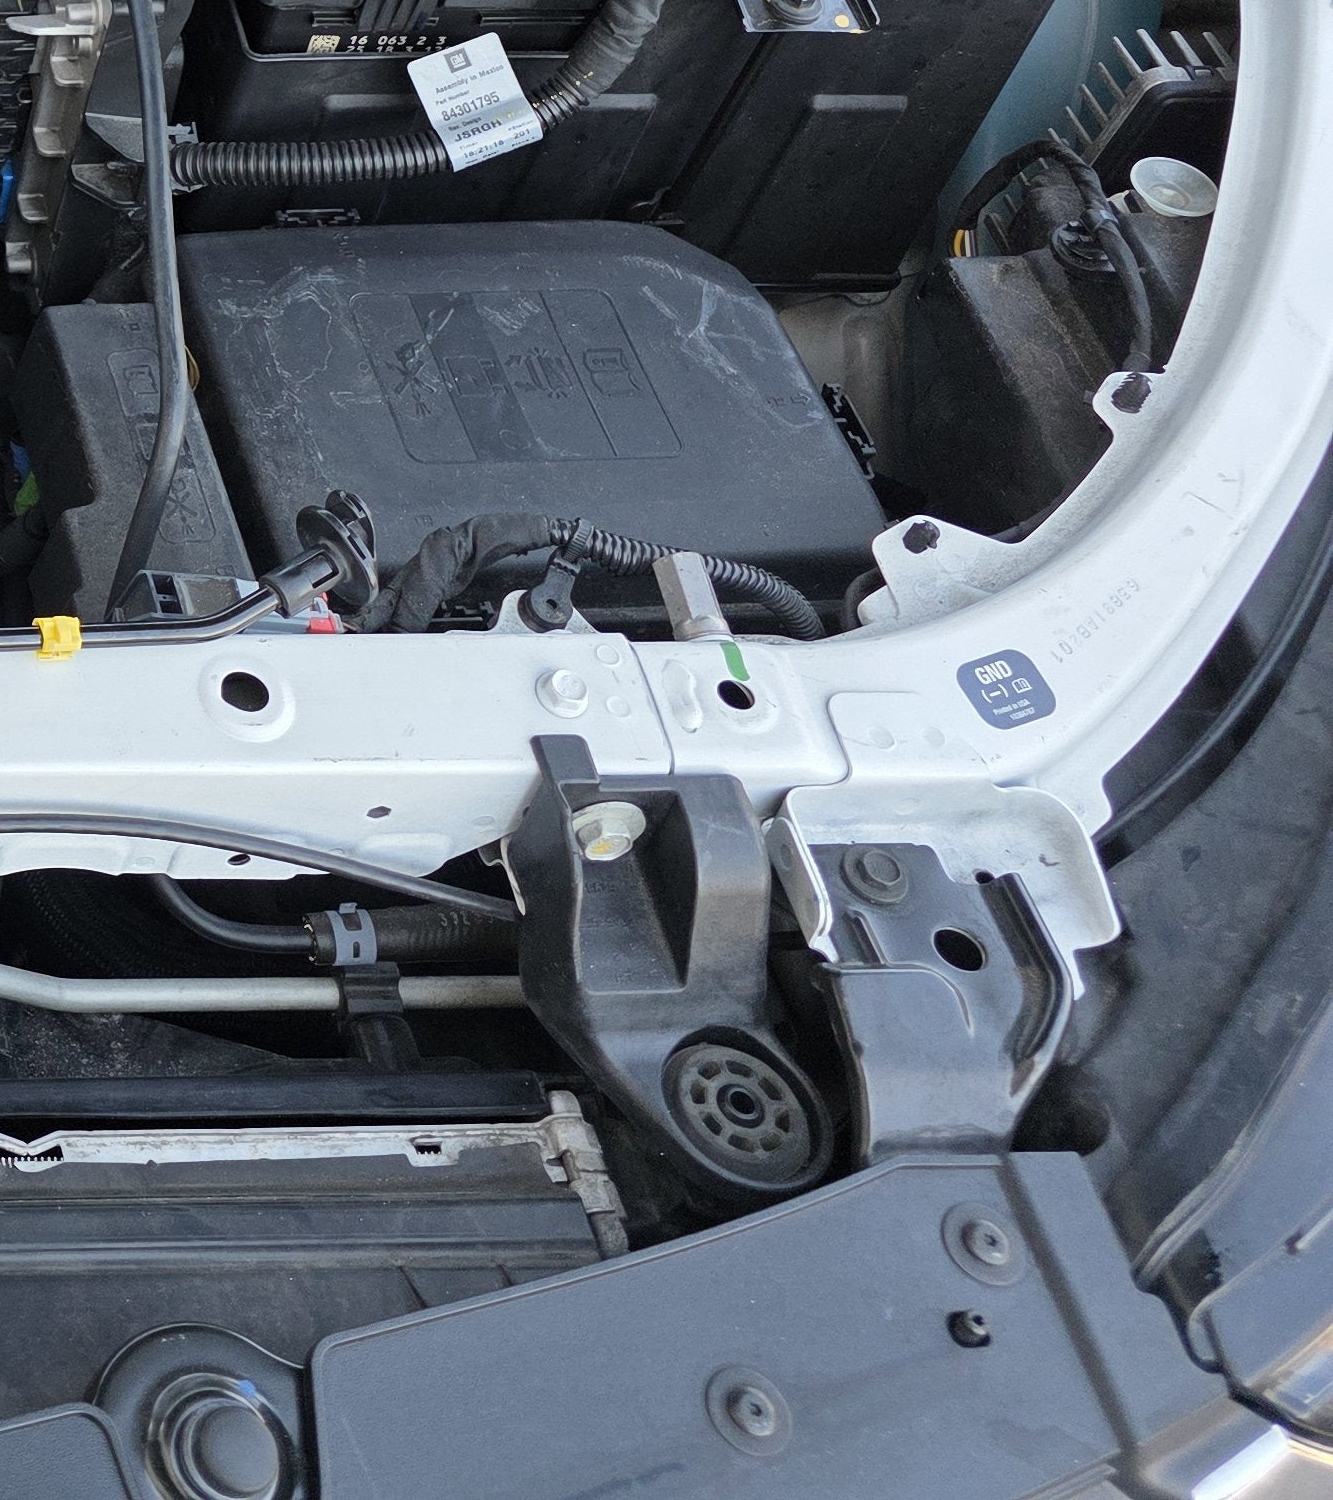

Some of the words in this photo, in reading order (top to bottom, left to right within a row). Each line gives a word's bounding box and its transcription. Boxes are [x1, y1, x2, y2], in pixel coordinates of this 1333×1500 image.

[349, 35, 369, 46] 16
[377, 35, 408, 46] 063
[416, 35, 427, 46] 2
[435, 35, 448, 46] 3
[435, 77, 469, 94] Assembly
[479, 63, 505, 78] Mexico
[441, 91, 501, 122] 84301795
[454, 118, 503, 143] JSRGH
[974, 660, 1013, 685] GND
